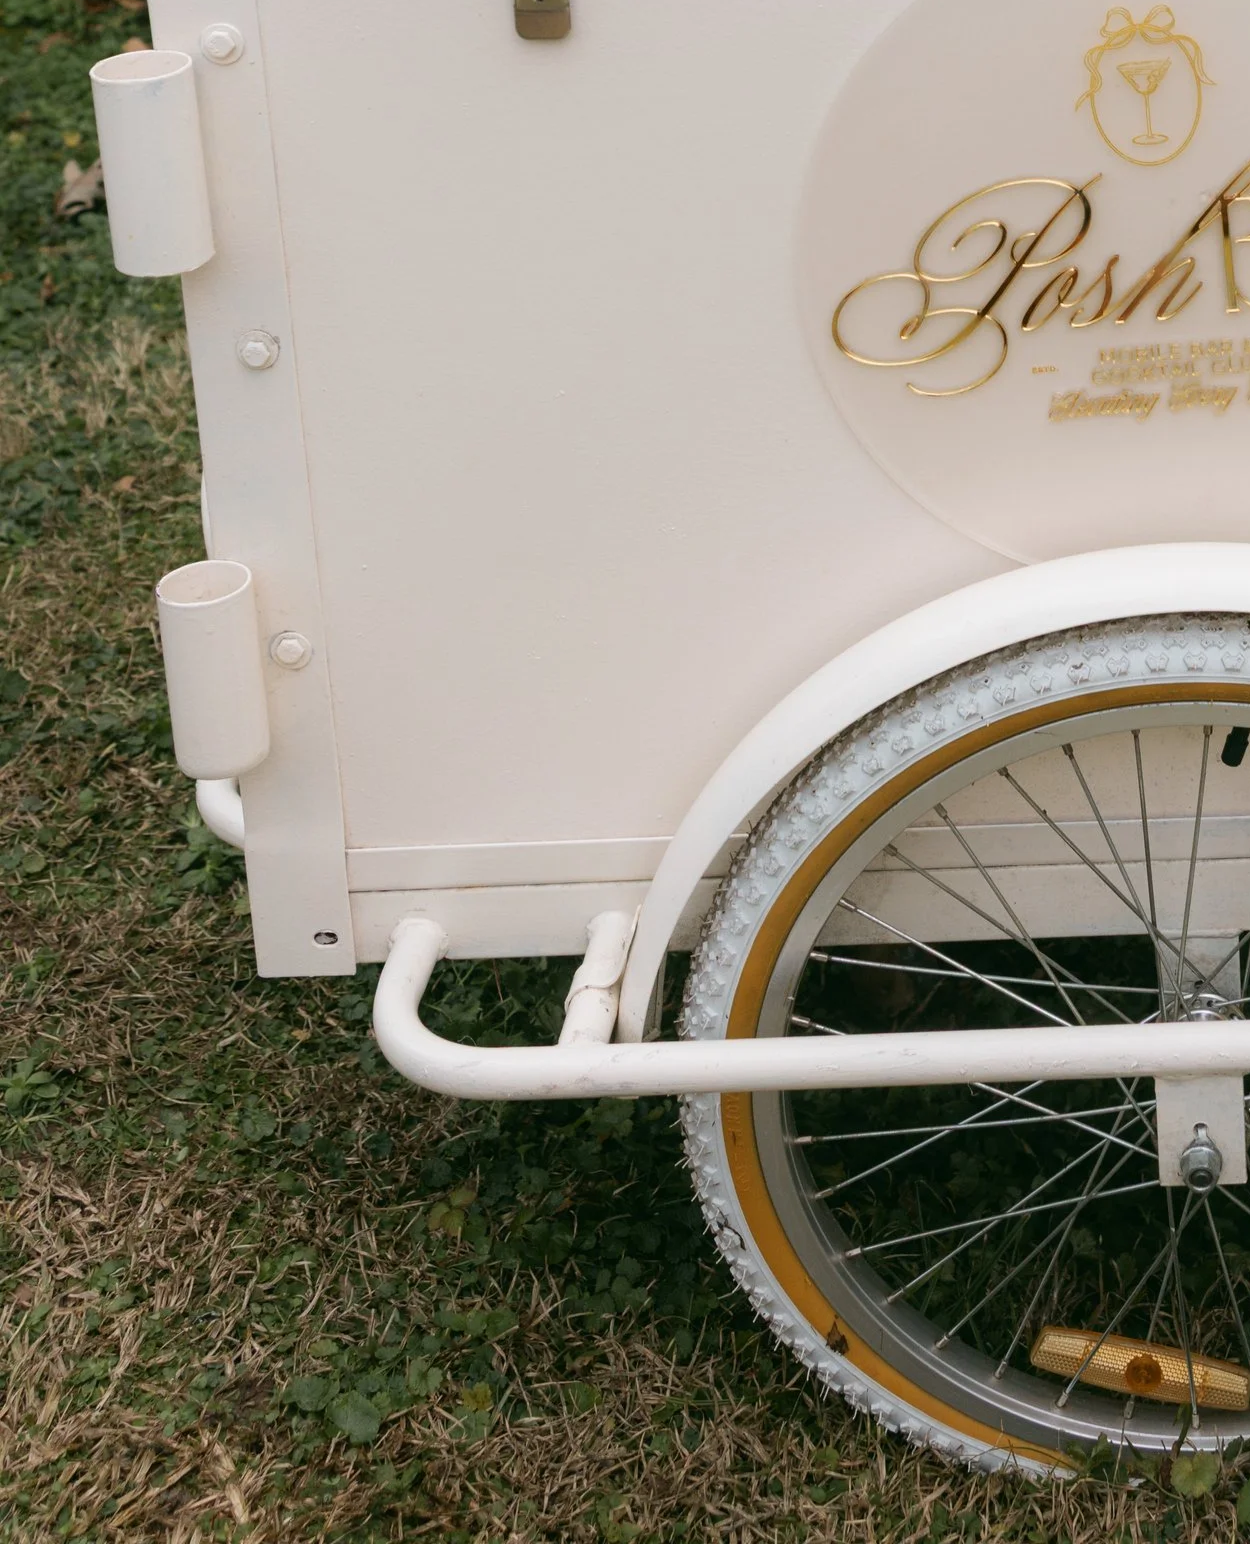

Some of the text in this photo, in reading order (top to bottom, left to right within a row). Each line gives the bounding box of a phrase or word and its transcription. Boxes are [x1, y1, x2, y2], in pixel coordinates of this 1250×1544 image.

[1098, 341, 1183, 364] MOBILE
[1190, 338, 1234, 359] BAR
[1091, 359, 1201, 386] COCKTAIL
